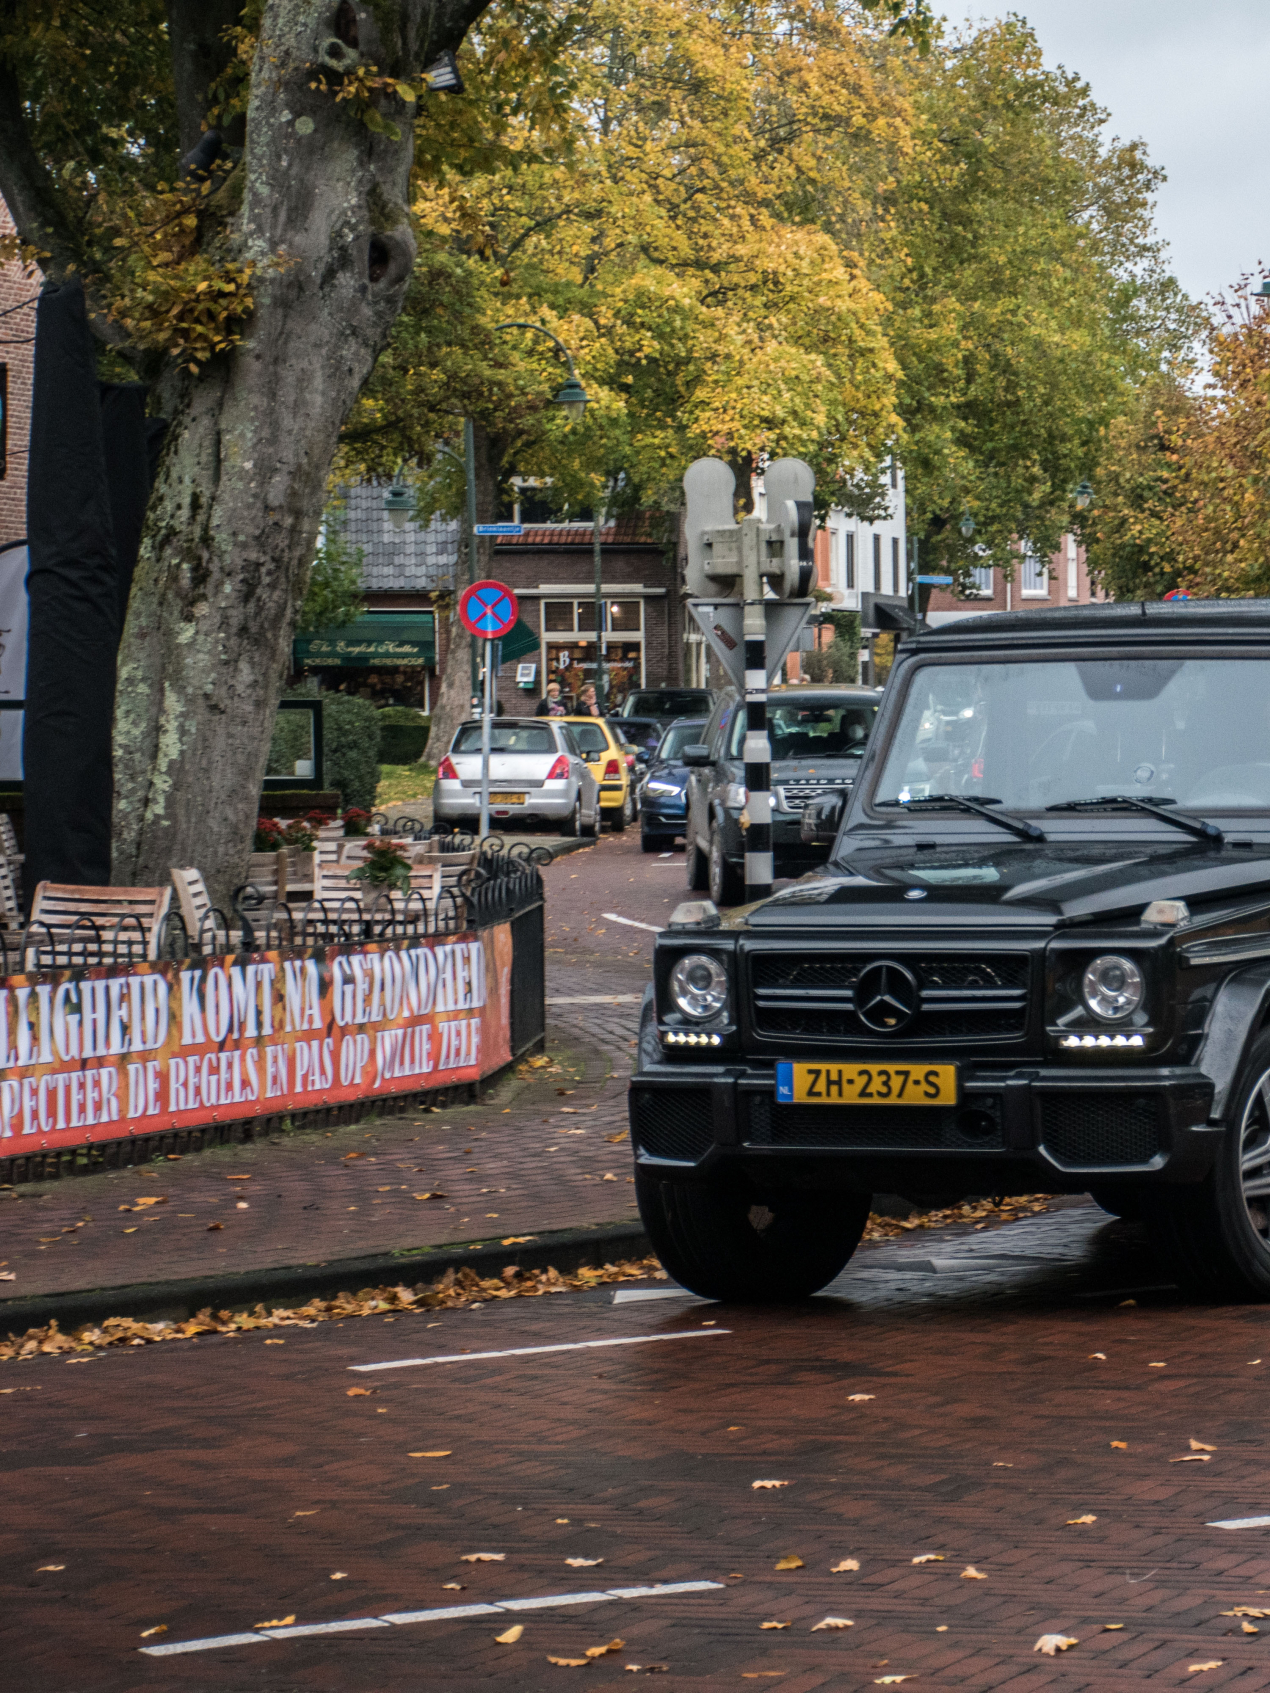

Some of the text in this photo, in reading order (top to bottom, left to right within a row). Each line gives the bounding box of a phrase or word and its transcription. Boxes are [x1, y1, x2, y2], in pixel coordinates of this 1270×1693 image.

[309, 639, 419, 656] The English Hatter
[303, 658, 341, 666] HOEDEN
[369, 657, 425, 666] HERENMODE
[180, 961, 275, 1046] KOMT
[284, 959, 323, 1033] NA
[0, 1017, 482, 1138] PECTEER DE REGELS EN PAS OP JULLIE ZELF
[779, 1068, 941, 1098] NL ZH-237-S
